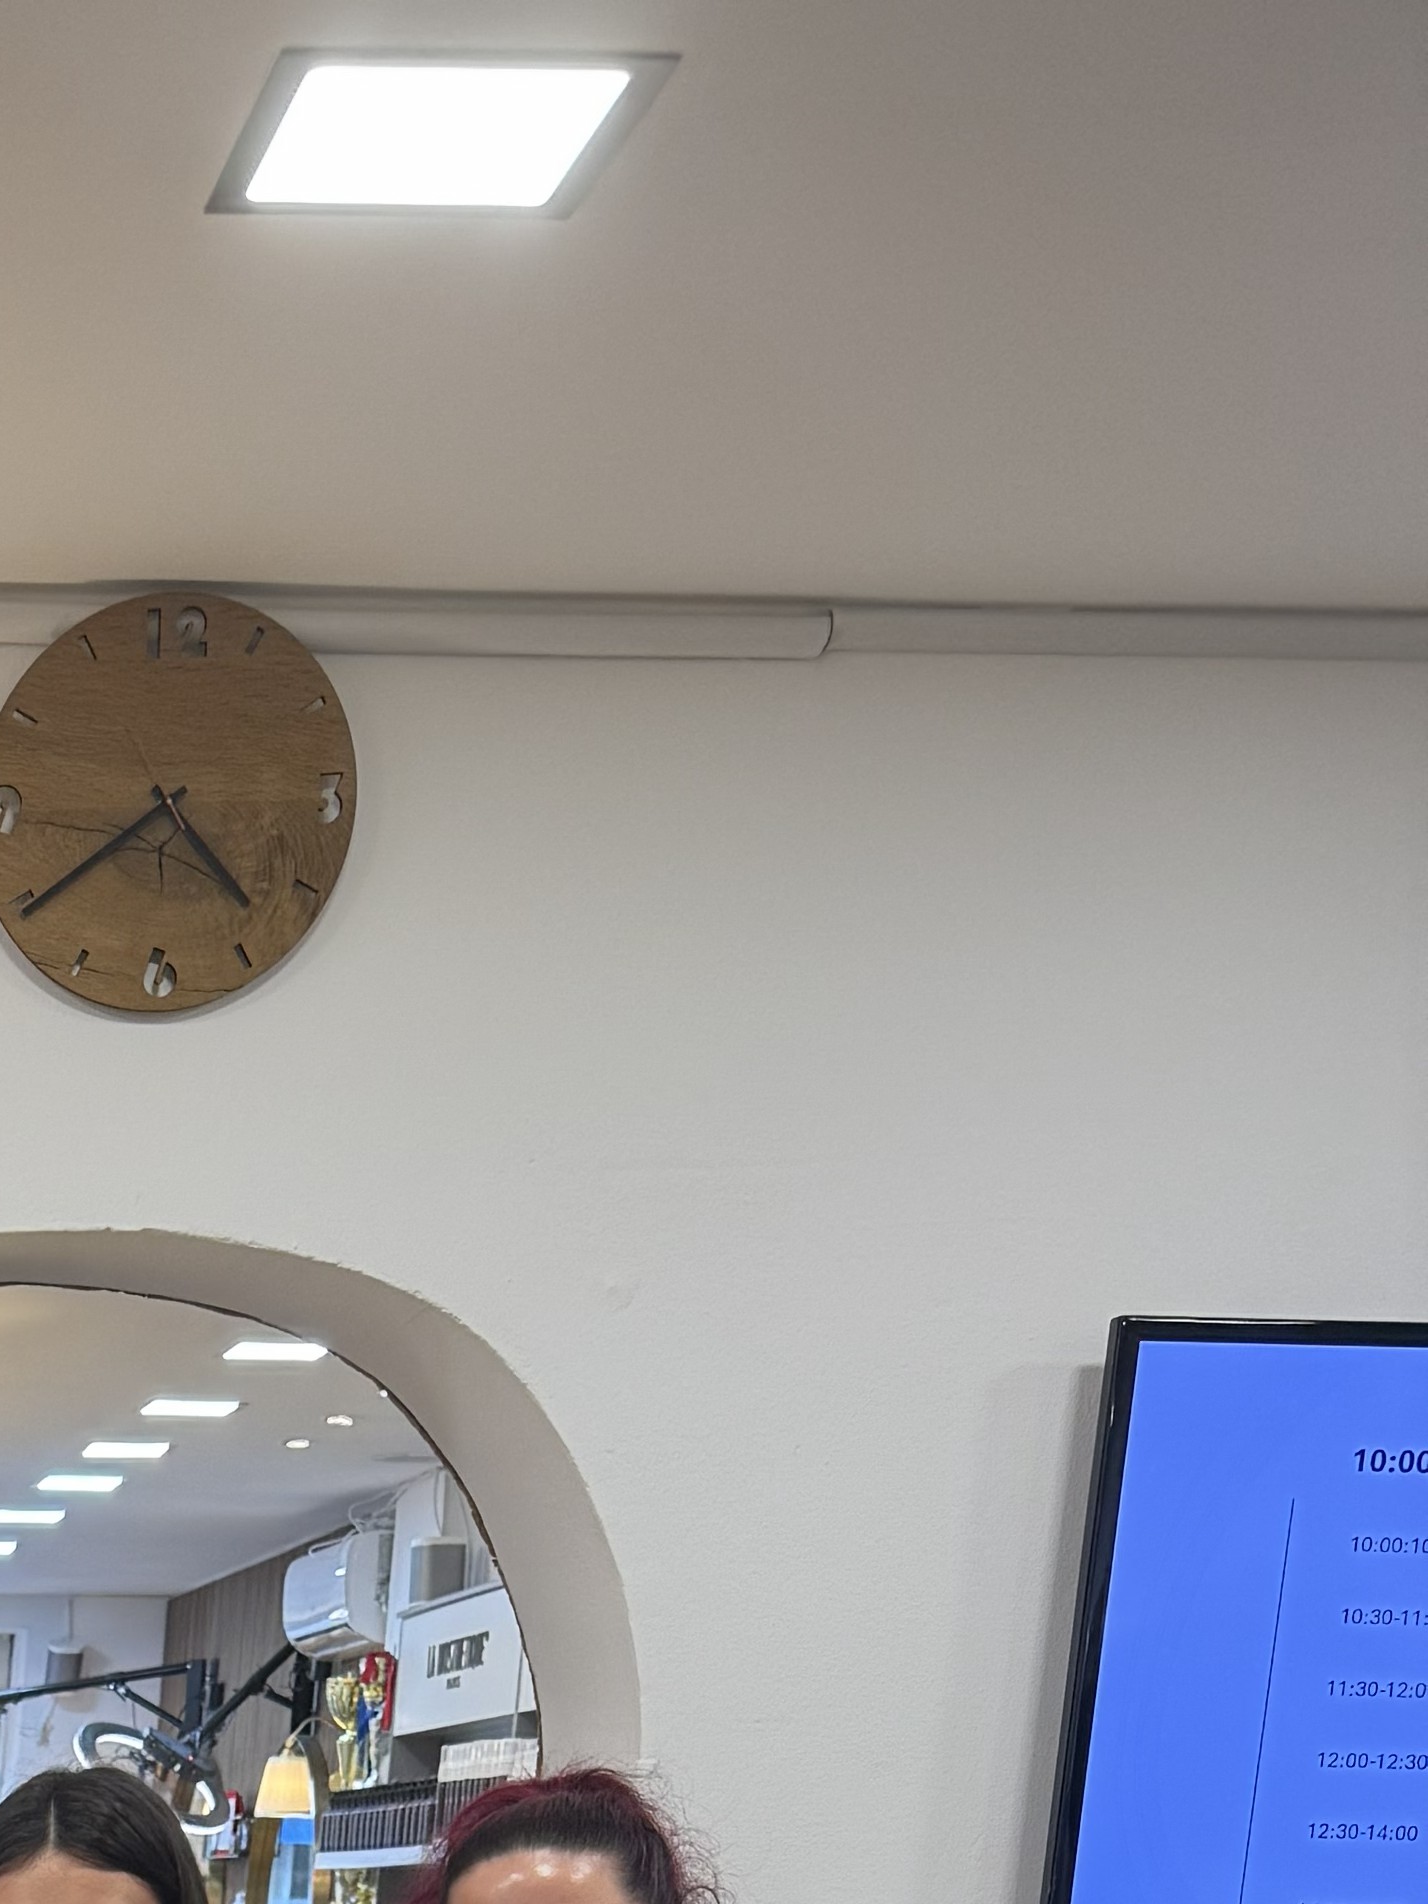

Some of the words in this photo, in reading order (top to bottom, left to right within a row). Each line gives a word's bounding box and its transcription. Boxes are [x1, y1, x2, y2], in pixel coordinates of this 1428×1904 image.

[146, 605, 209, 660] 12
[317, 772, 344, 825] 3
[142, 946, 178, 998] 6
[1318, 1752, 1428, 1770] 12:00-12:30
[1308, 1823, 1419, 1841] 12:30-14:00
